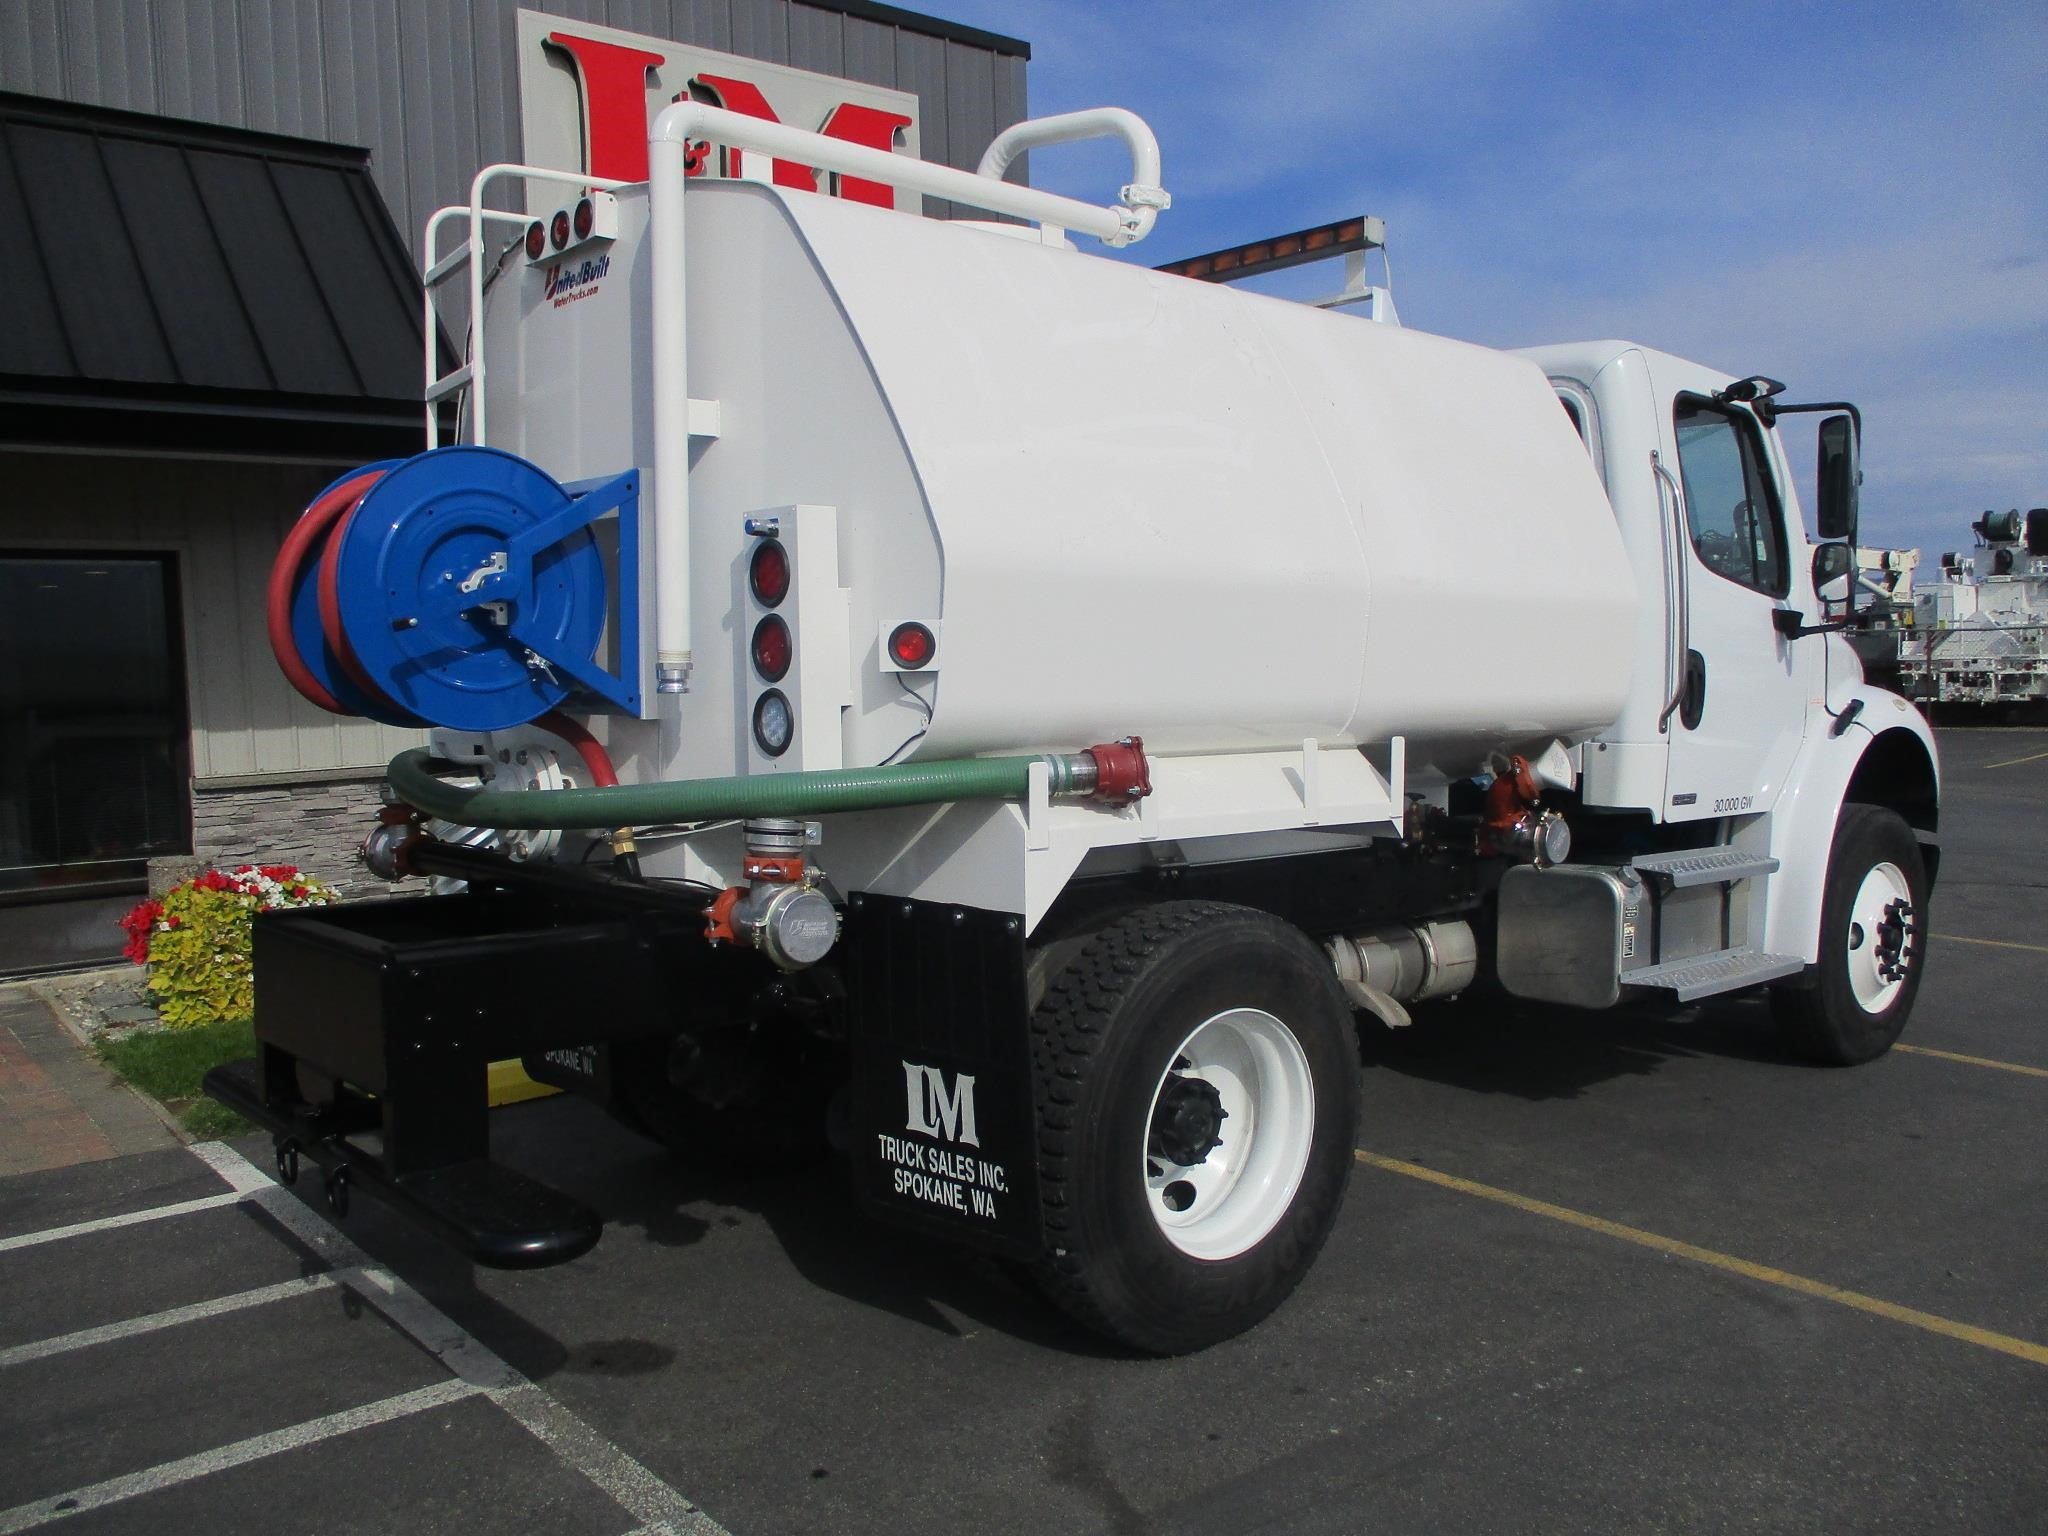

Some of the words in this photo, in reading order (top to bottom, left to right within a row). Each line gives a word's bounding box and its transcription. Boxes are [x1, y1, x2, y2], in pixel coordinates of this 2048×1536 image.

[544, 255, 611, 301] UnitedBuilt
[1713, 797, 1739, 813] 30,000
[902, 1059, 980, 1149] LM
[878, 1133, 926, 1171] TRUCK
[929, 1147, 975, 1183] SALES
[979, 1160, 1009, 1194] INC.
[894, 1167, 968, 1216] SPOKANE,
[970, 1187, 997, 1220] WA
